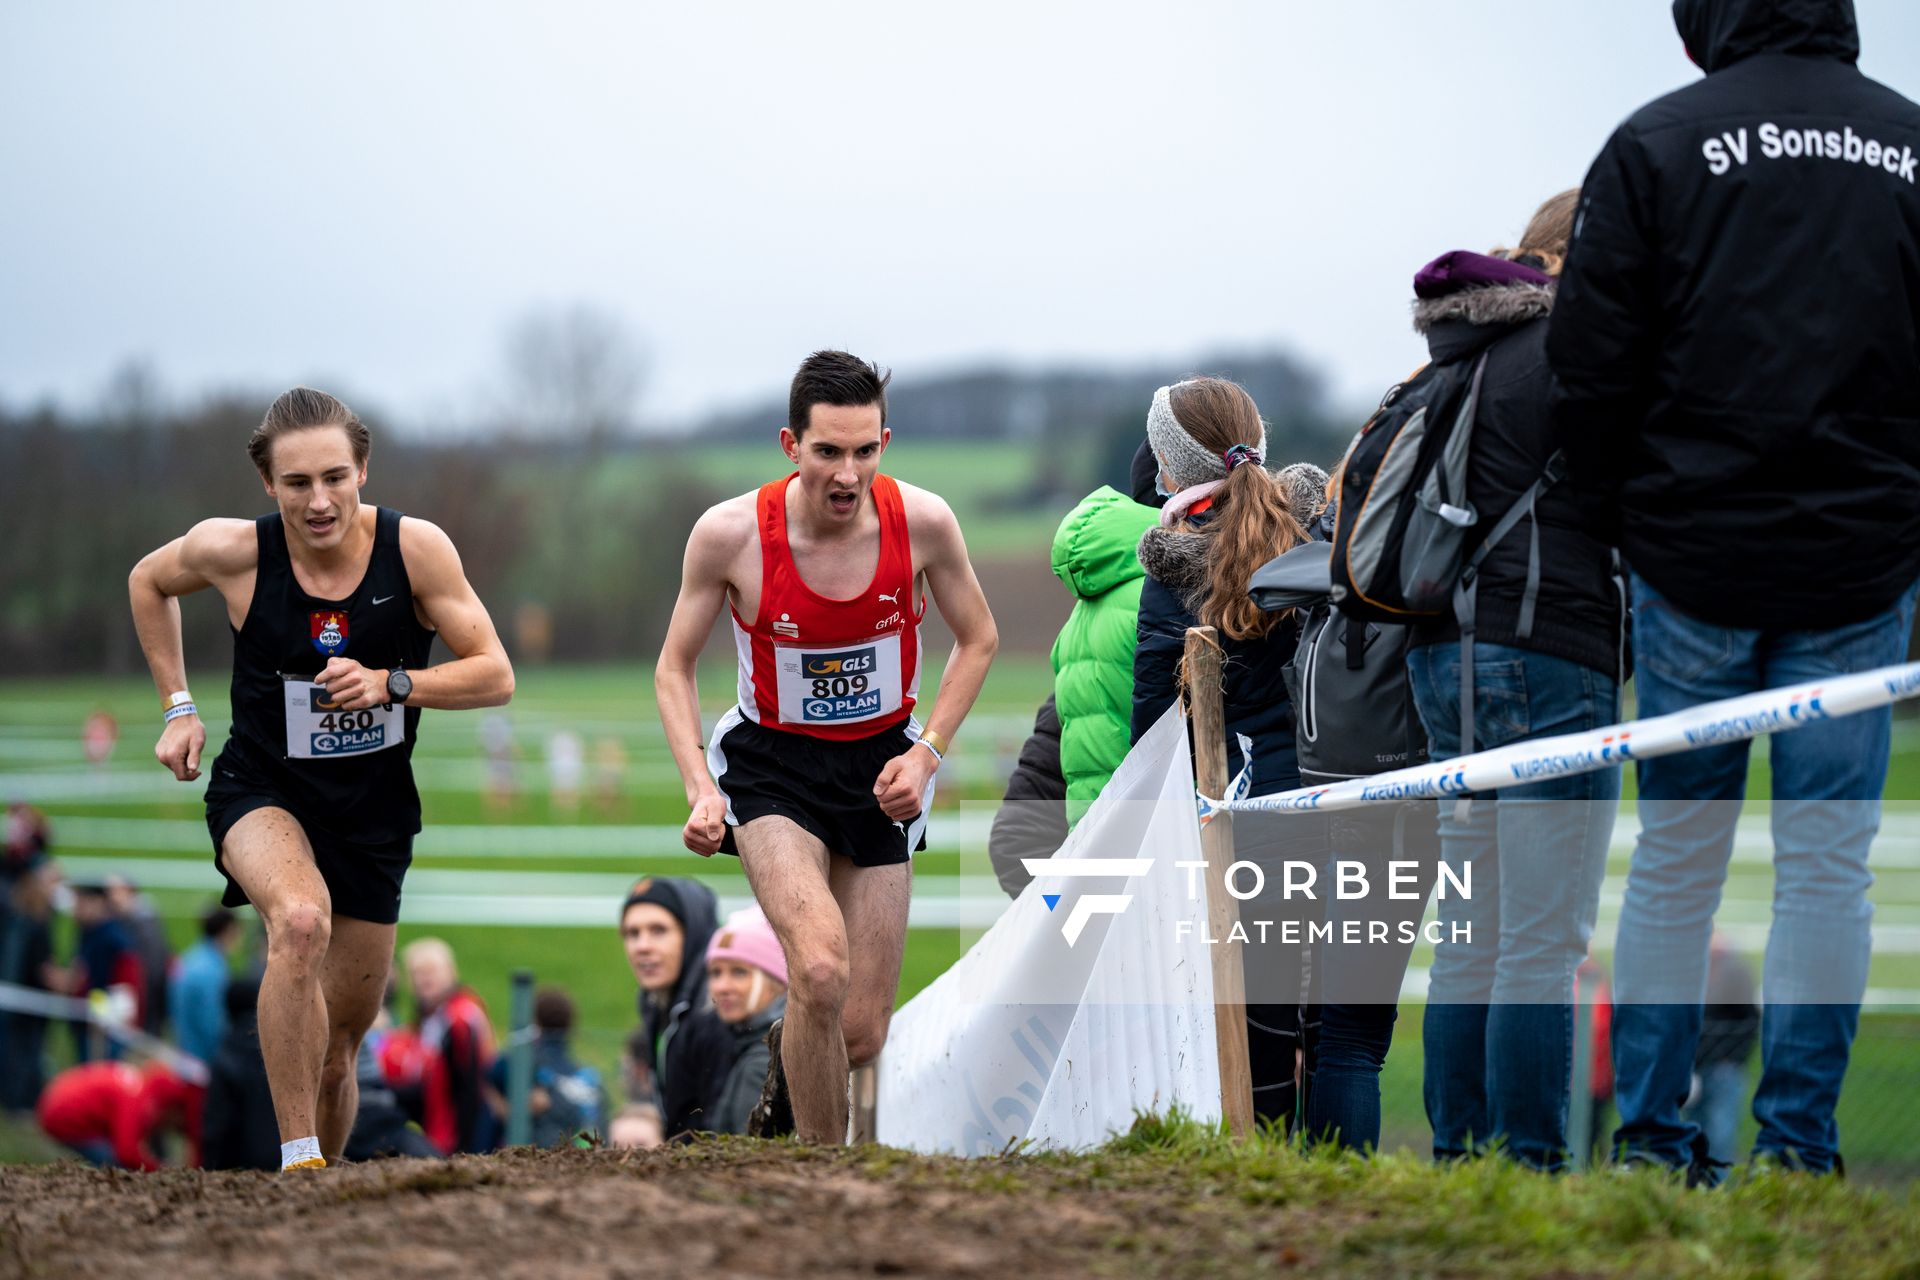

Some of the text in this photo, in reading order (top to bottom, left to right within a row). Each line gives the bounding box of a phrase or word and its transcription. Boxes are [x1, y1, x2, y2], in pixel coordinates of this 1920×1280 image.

[1702, 122, 1919, 184] SV Sonsbeck
[841, 655, 870, 672] GLS
[811, 674, 868, 698] 809
[836, 695, 878, 711] PLAN
[836, 706, 878, 716] INTERNATIONAL
[319, 710, 374, 732] 460
[342, 729, 382, 745] PLAN
